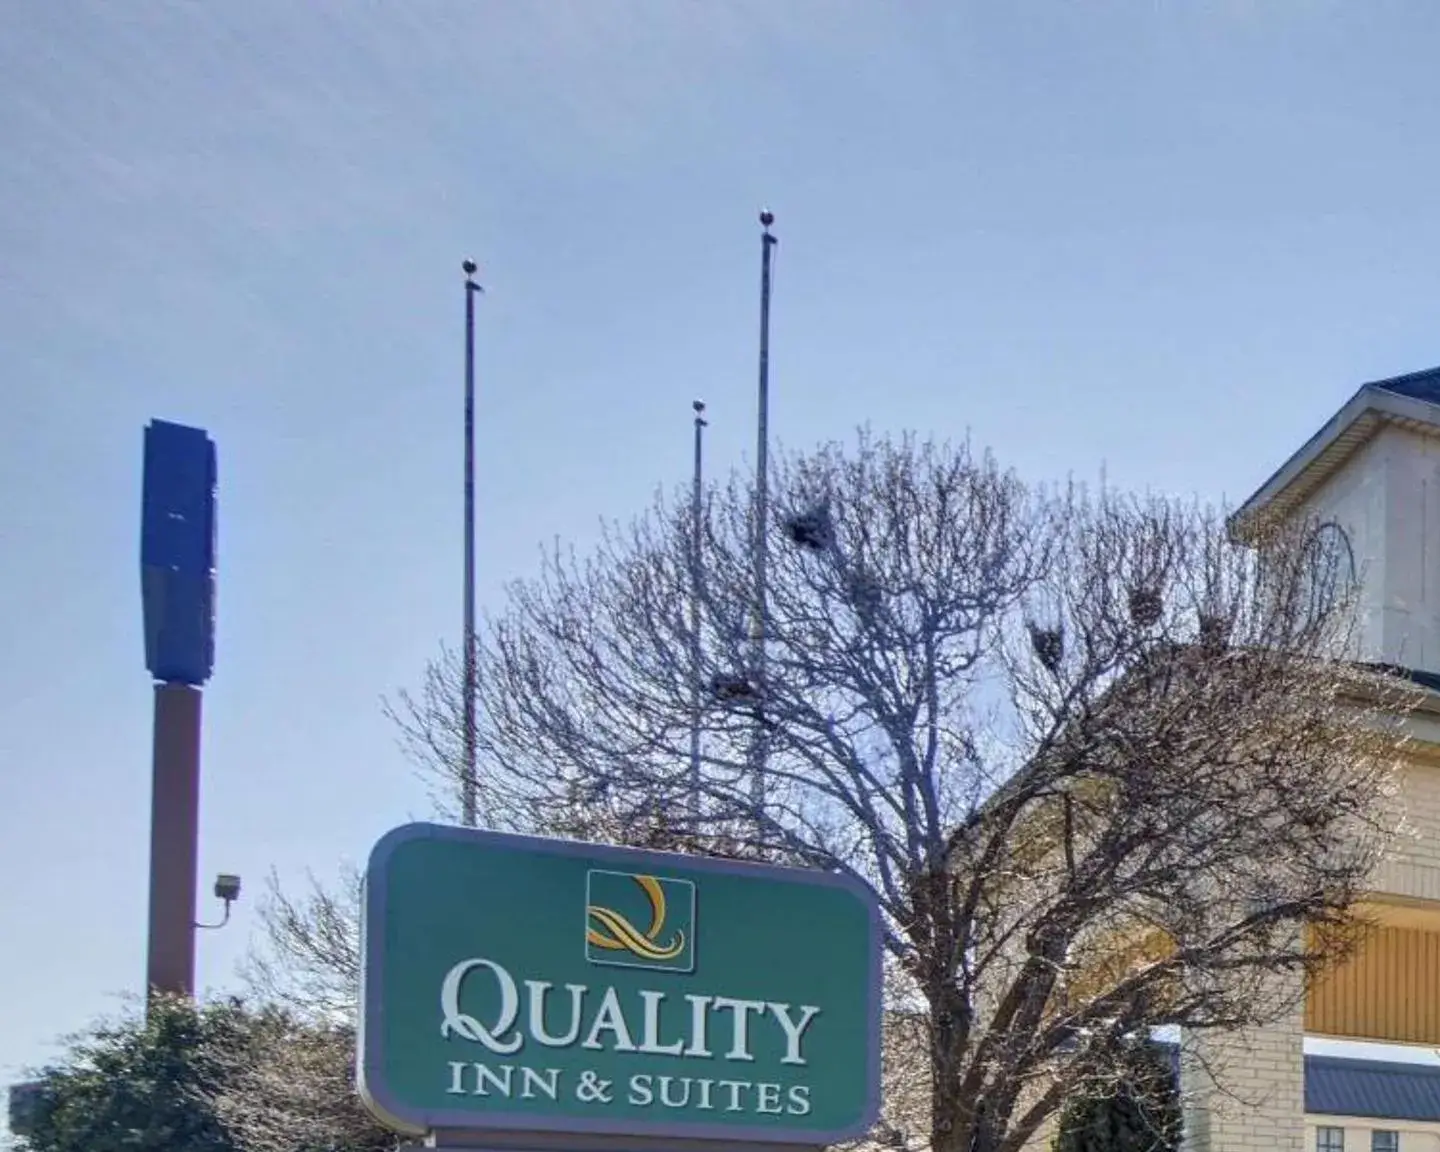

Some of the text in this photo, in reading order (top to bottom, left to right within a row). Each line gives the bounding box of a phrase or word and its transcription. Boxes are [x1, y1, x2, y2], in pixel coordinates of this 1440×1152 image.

[440, 957, 821, 1065] QUALITY
[446, 1061, 812, 1116] INN & SUITES
